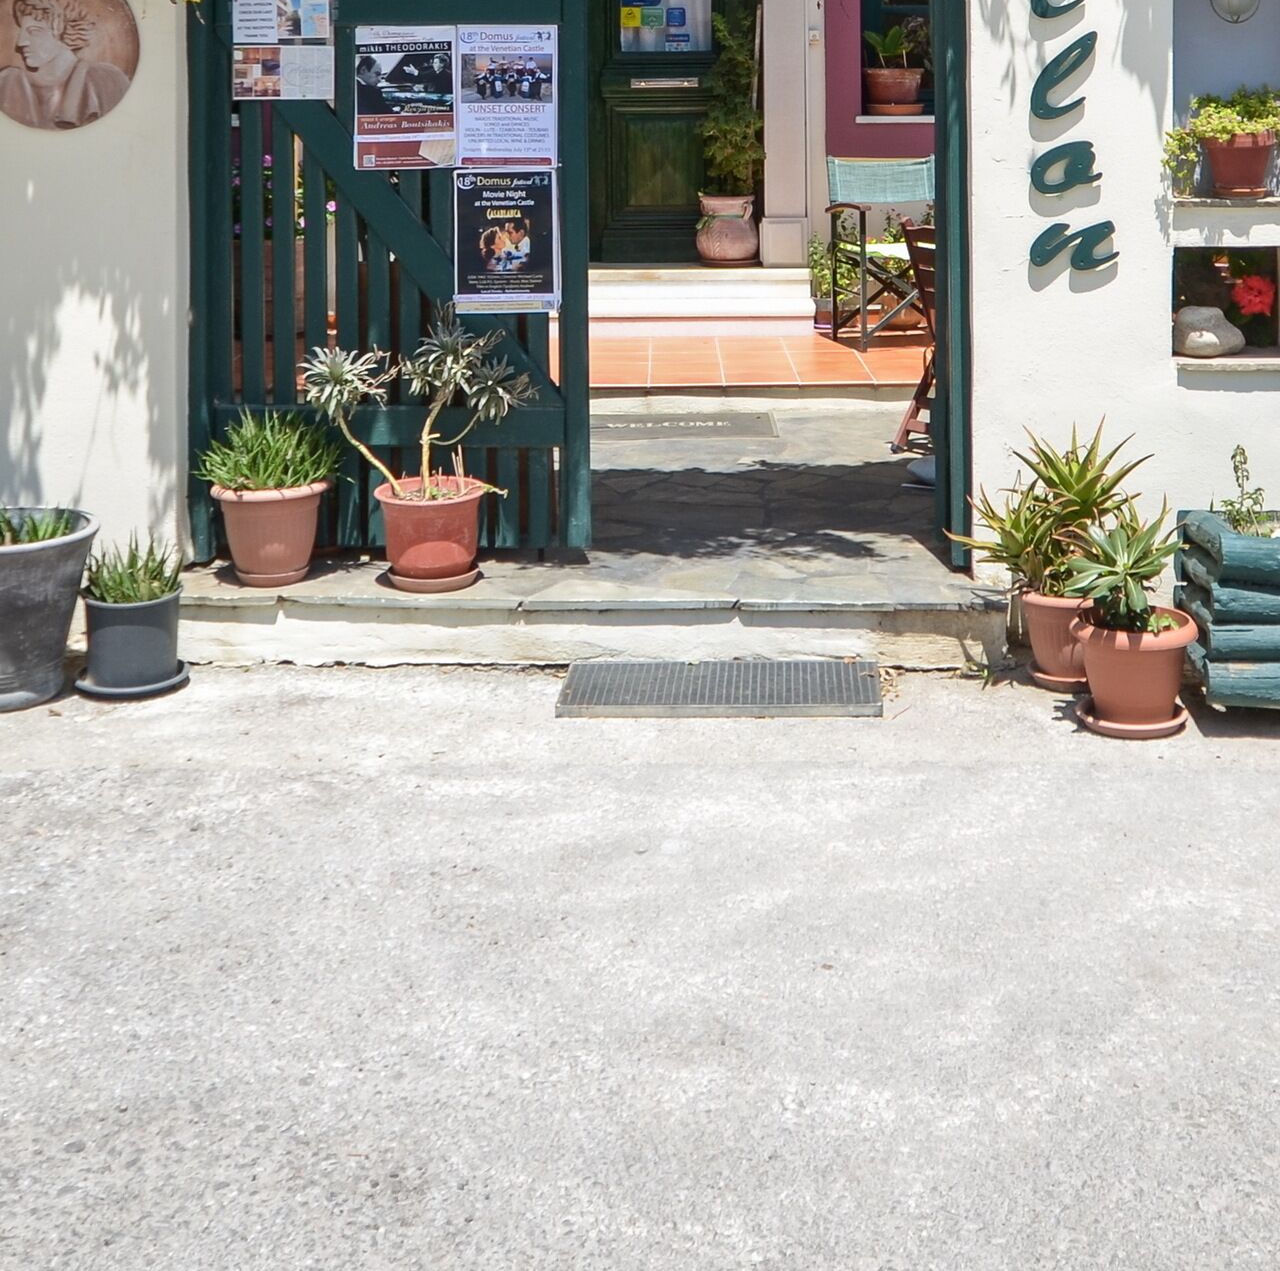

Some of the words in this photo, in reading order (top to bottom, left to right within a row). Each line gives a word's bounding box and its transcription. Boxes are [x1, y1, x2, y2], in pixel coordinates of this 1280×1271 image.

[480, 31, 514, 41] Domus
[385, 42, 449, 52] THEODORAKIS
[467, 104, 502, 114] SUNSET
[504, 104, 546, 114] CONSERT
[361, 121, 397, 129] Andreas
[477, 176, 511, 186] Domus
[482, 190, 505, 198] Movie
[505, 190, 526, 198] Night
[607, 420, 732, 428] WELCOME
